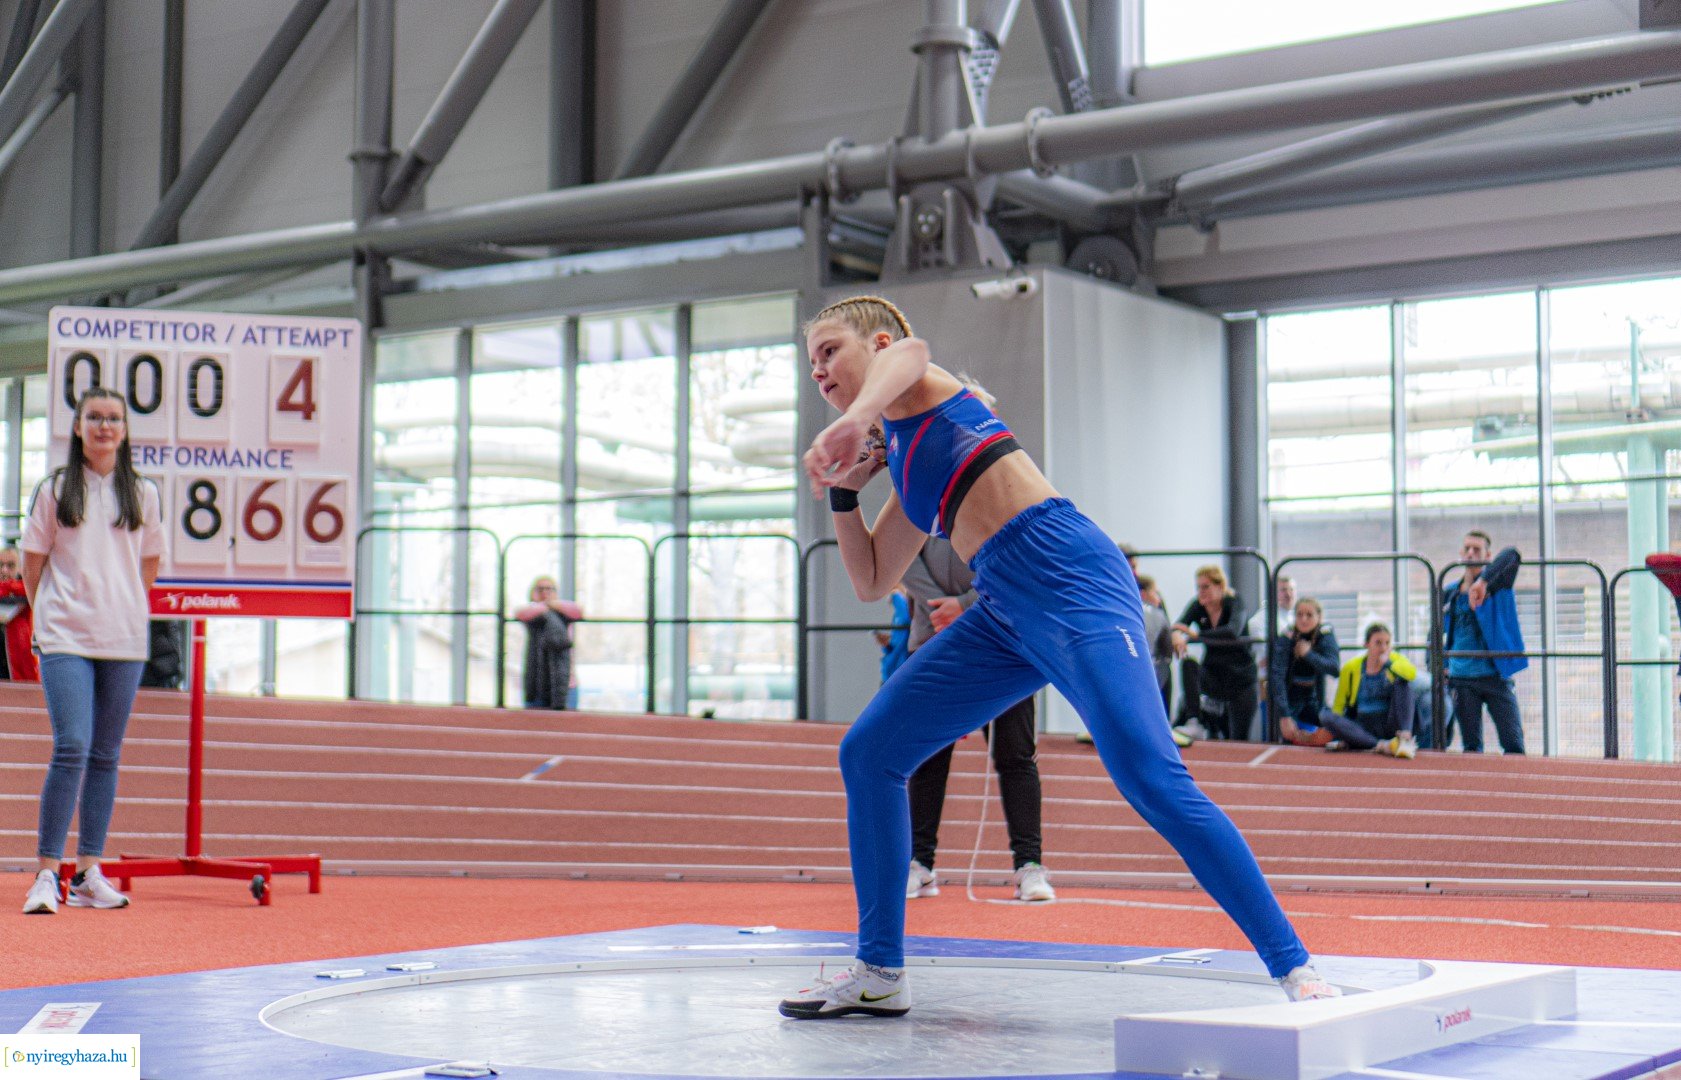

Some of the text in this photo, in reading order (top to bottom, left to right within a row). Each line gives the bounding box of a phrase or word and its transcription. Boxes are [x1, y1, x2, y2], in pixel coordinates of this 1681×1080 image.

[57, 317, 354, 348] COMPETITOR / ATTEMPT
[276, 358, 316, 420] 4
[130, 445, 293, 469] ERFORMANCE
[181, 594, 239, 611] polanik
